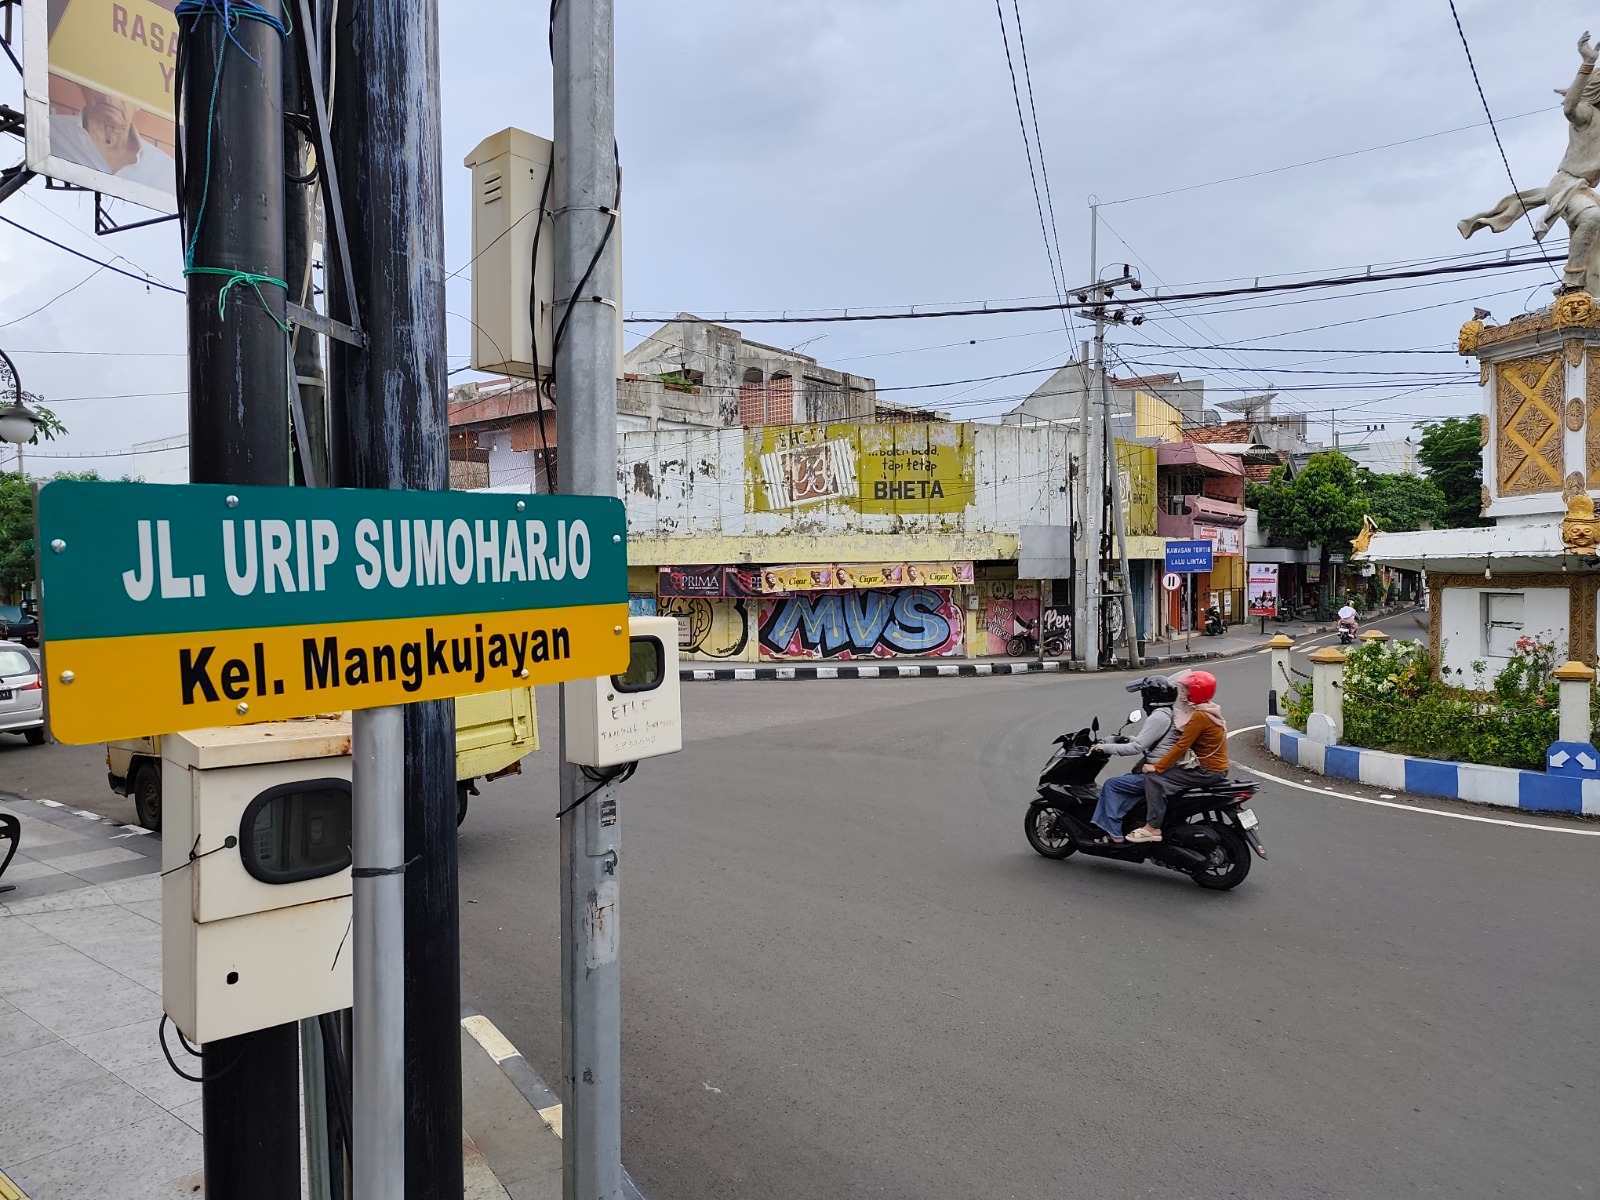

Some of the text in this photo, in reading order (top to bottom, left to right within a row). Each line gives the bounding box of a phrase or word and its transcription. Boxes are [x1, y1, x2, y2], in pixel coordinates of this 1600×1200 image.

[881, 457, 938, 477] tapi tetap
[874, 480, 944, 500] BHETA
[122, 518, 591, 602] JL. URIP SUMOHARJO
[1166, 546, 1192, 554] KAWASAN
[788, 577, 808, 586] Cigar
[859, 574, 880, 585] Cigar
[929, 572, 950, 581] Cigar
[763, 588, 951, 655] MVS
[179, 623, 571, 705] Kel. Mangkujayan
